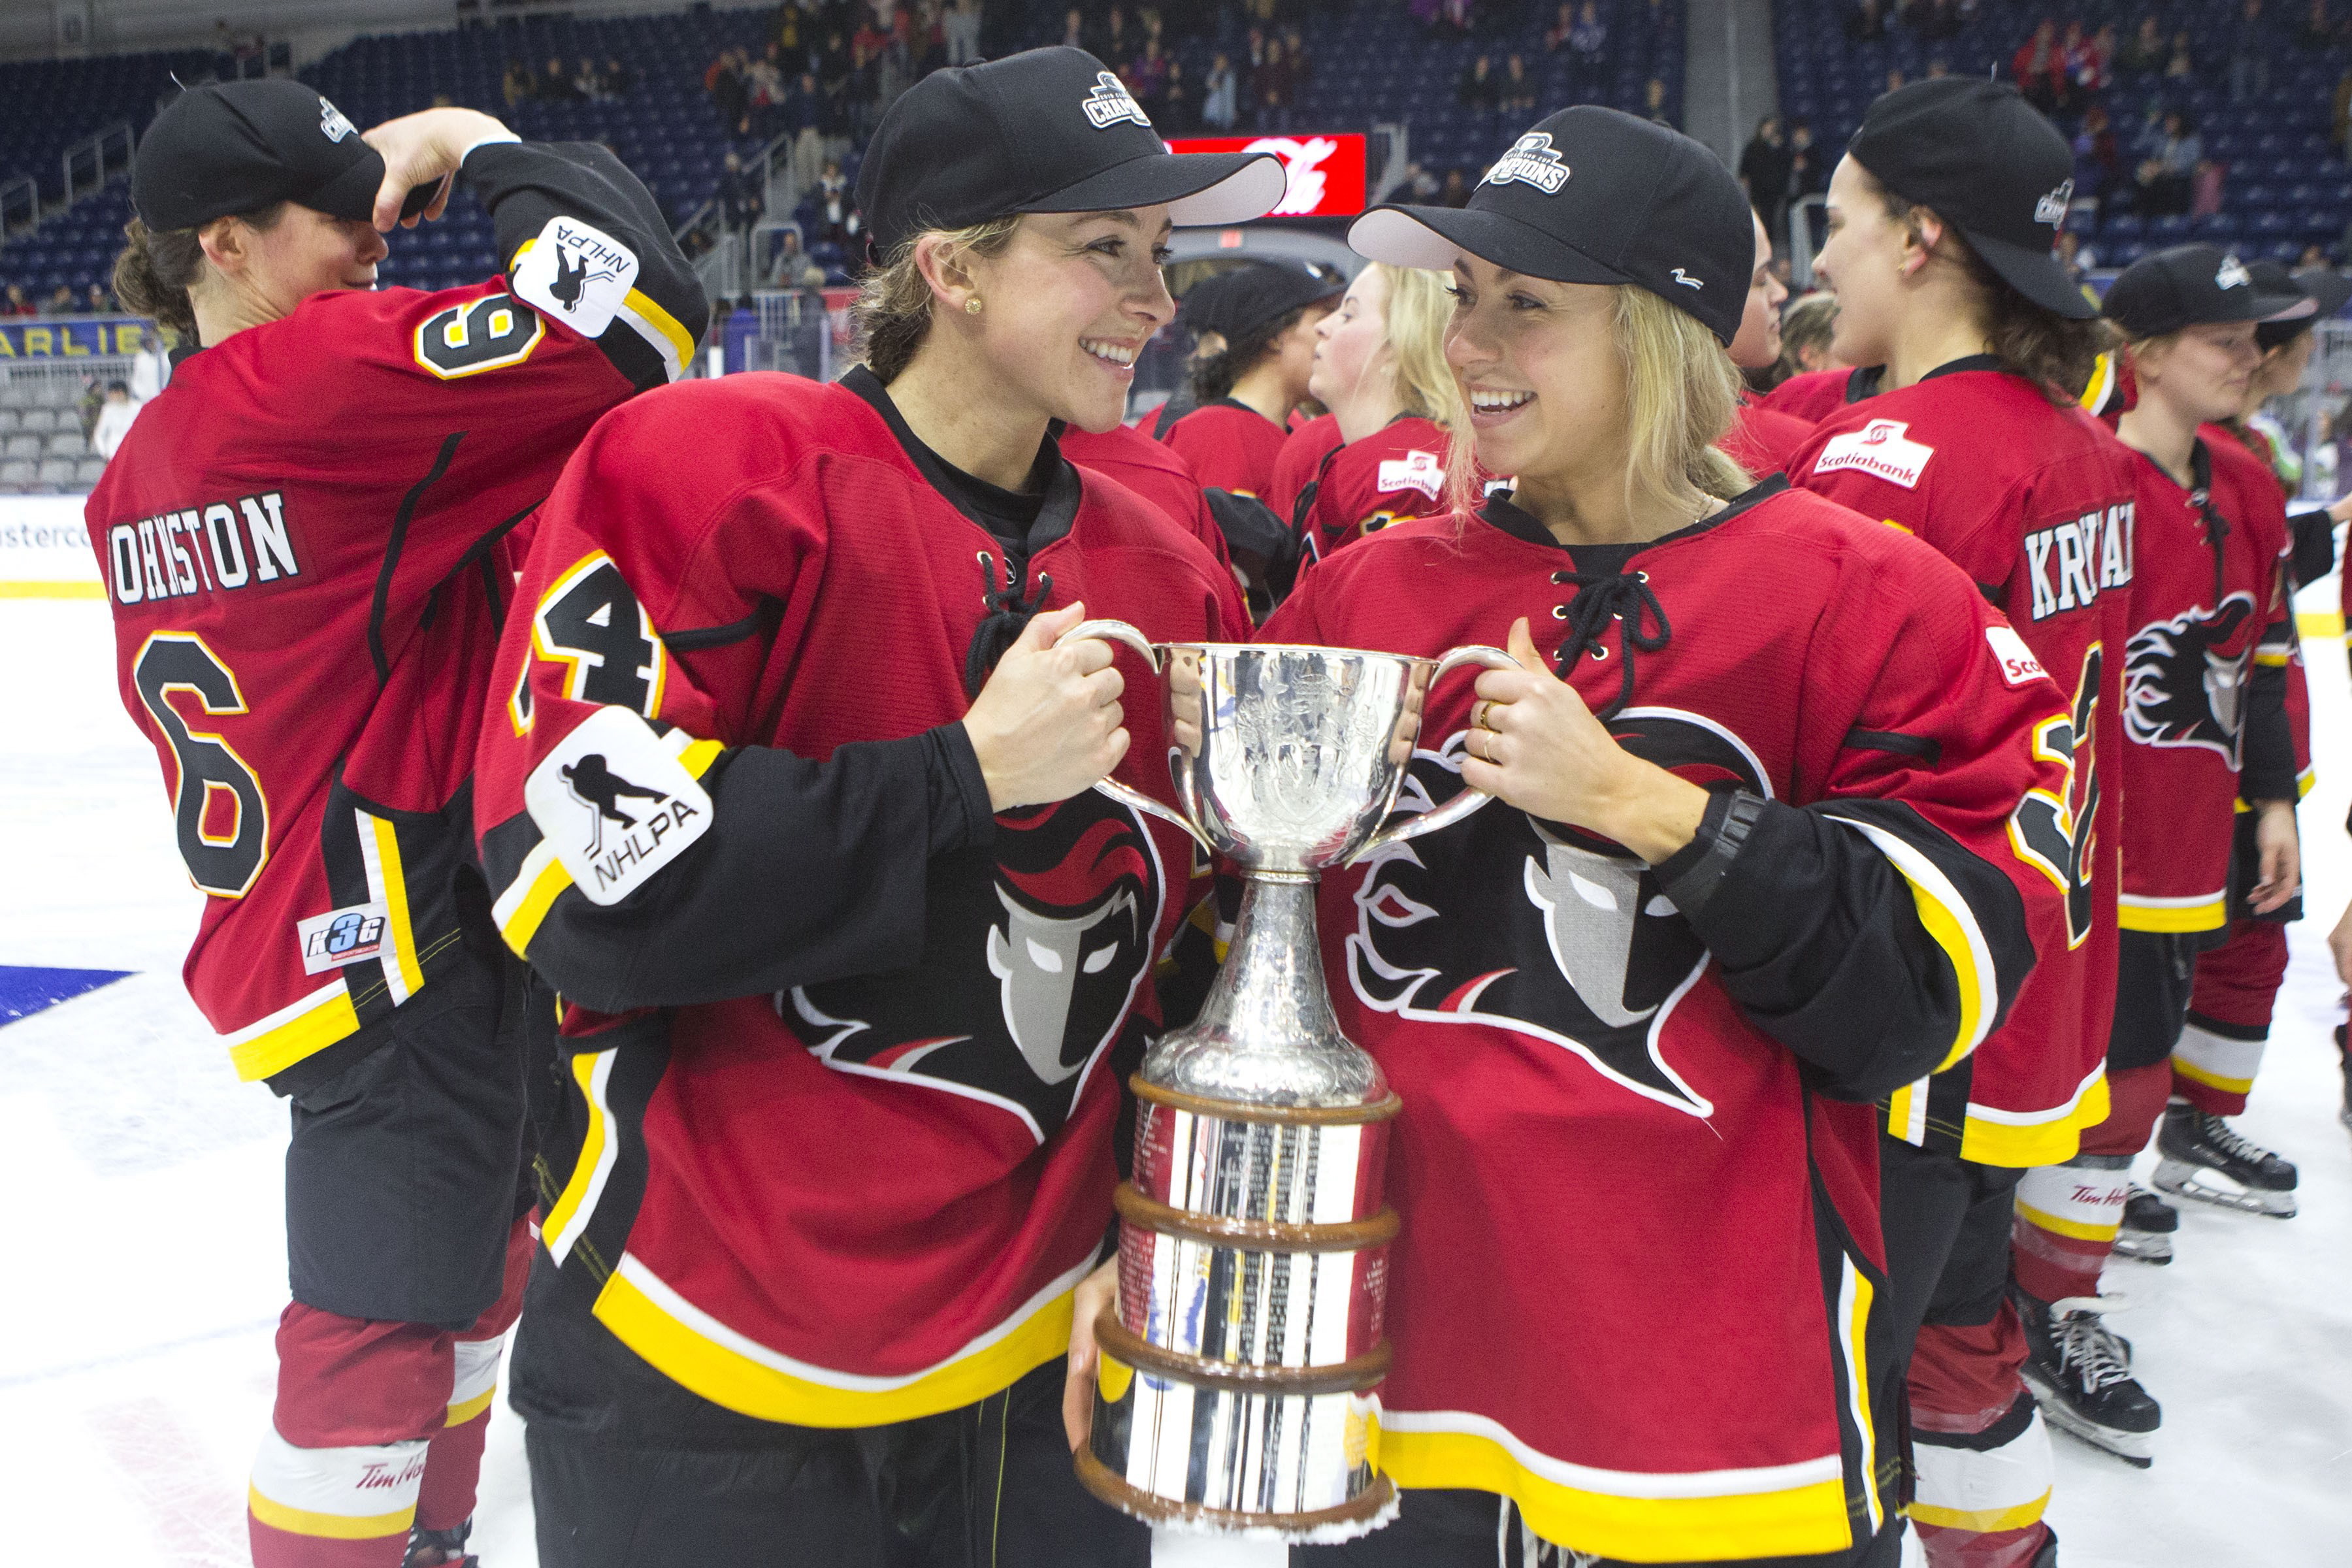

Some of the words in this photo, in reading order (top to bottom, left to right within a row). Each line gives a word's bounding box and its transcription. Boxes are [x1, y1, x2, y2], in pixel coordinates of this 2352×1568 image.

[557, 225, 630, 273] NHLPA
[1819, 452, 1916, 483] Scotiabank
[107, 491, 299, 605] OHNSTON
[133, 630, 270, 899] 6
[593, 798, 700, 892] NHLPA
[306, 913, 385, 958] K3G
[2070, 1183, 2102, 1205] Tim
[356, 1462, 396, 1489] Tim
